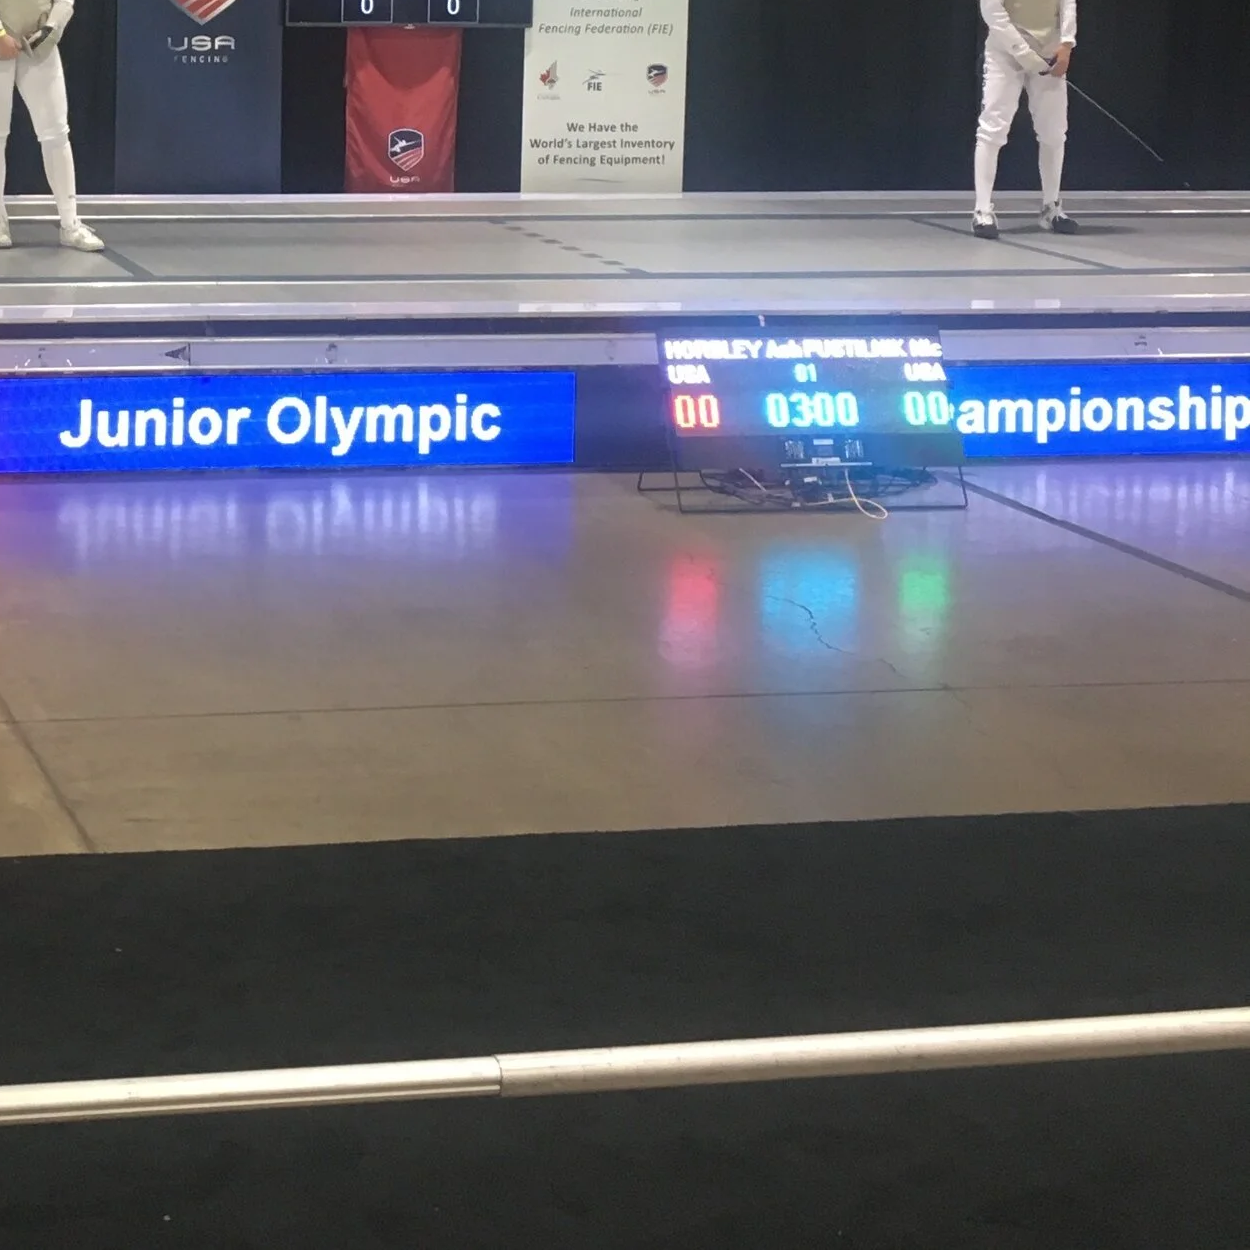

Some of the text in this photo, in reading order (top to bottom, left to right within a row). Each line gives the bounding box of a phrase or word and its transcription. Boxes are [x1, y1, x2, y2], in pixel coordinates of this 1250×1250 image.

[570, 7, 643, 18] International
[538, 23, 674, 37] Fencing Federation (FIE)
[167, 35, 235, 52] USA
[173, 55, 229, 64] FENCING
[587, 82, 602, 92] FIE
[566, 122, 639, 133] We Have the
[529, 138, 675, 151] World's Largest Inventory
[537, 154, 666, 167] of Fencing Equipment!
[389, 175, 420, 184] USA
[667, 364, 711, 385] USA
[903, 362, 947, 382] USA
[674, 394, 720, 429] 00
[766, 391, 860, 428] 0300
[904, 391, 950, 426] 00
[950, 384, 1250, 444] ampionship
[59, 393, 502, 457] Junior Olympic
